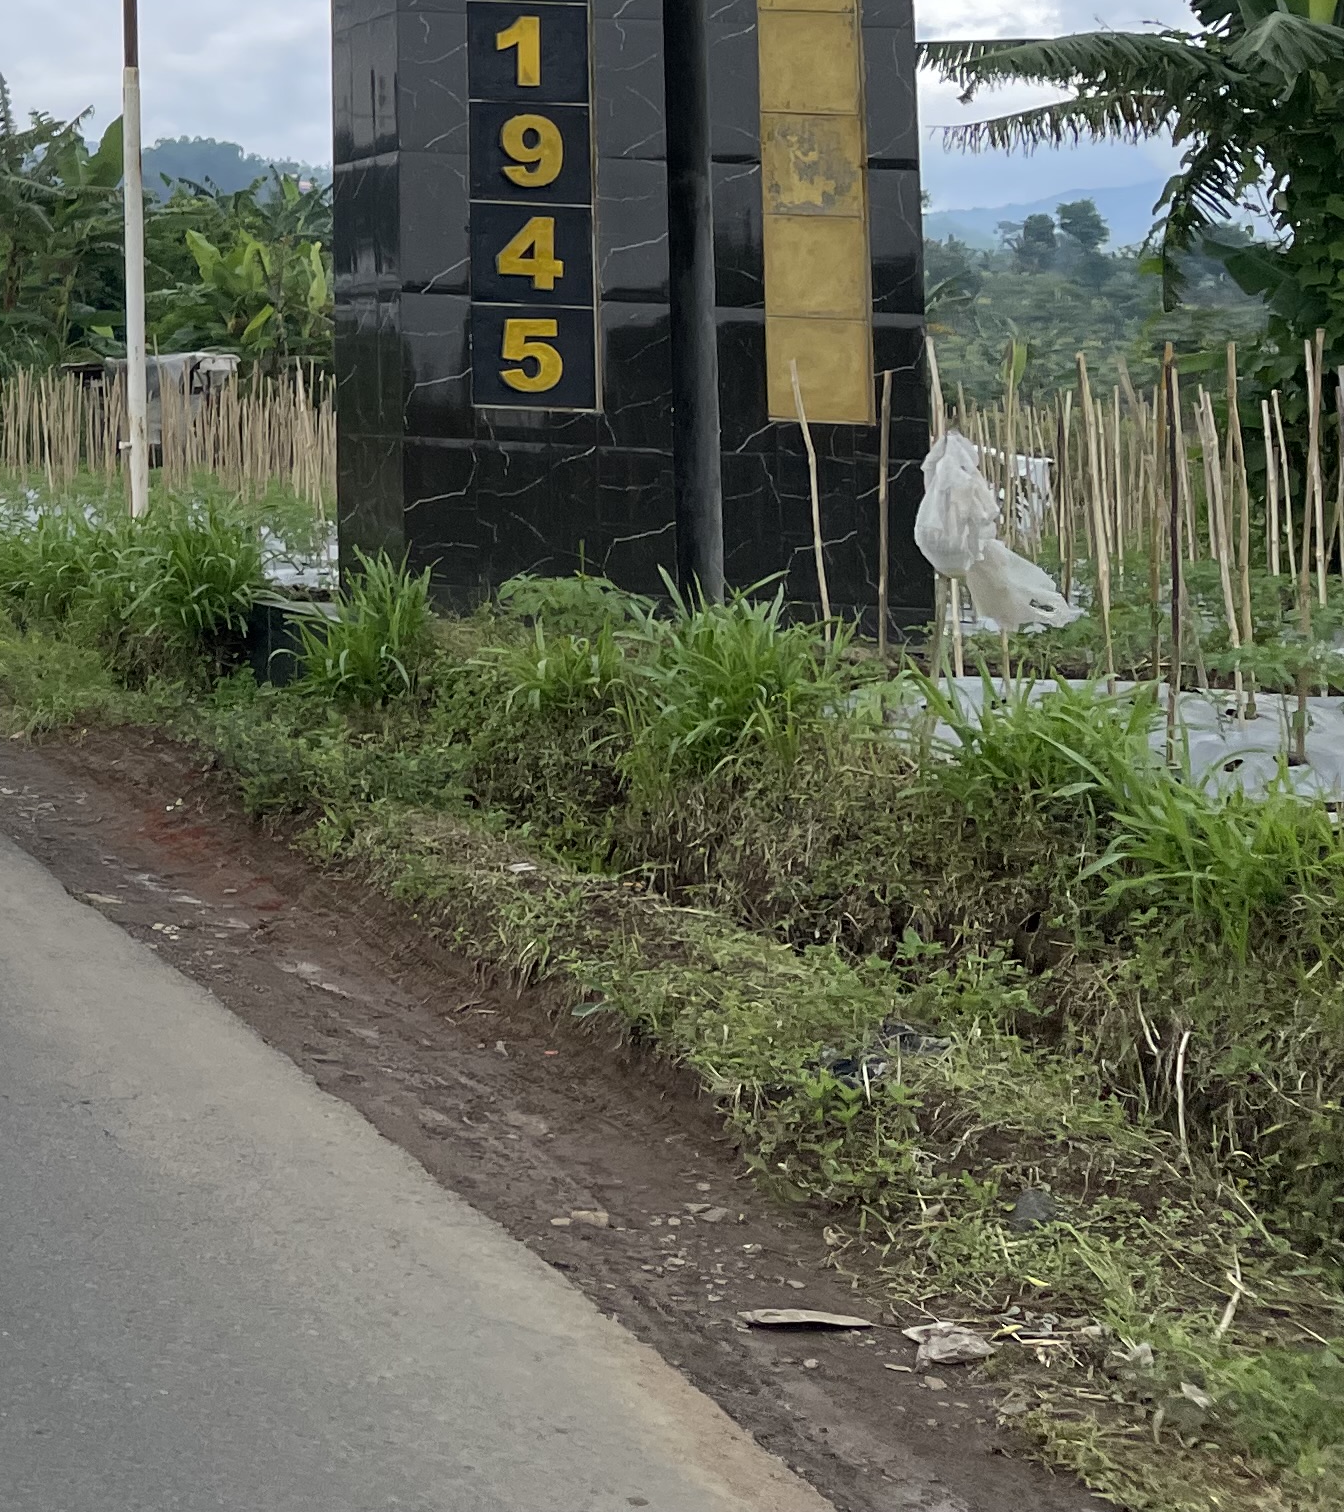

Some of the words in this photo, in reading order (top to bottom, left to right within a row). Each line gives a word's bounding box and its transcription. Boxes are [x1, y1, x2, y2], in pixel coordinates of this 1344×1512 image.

[496, 15, 541, 87] 1
[500, 113, 564, 188] 9
[496, 216, 564, 291] 4
[499, 318, 564, 393] 5
